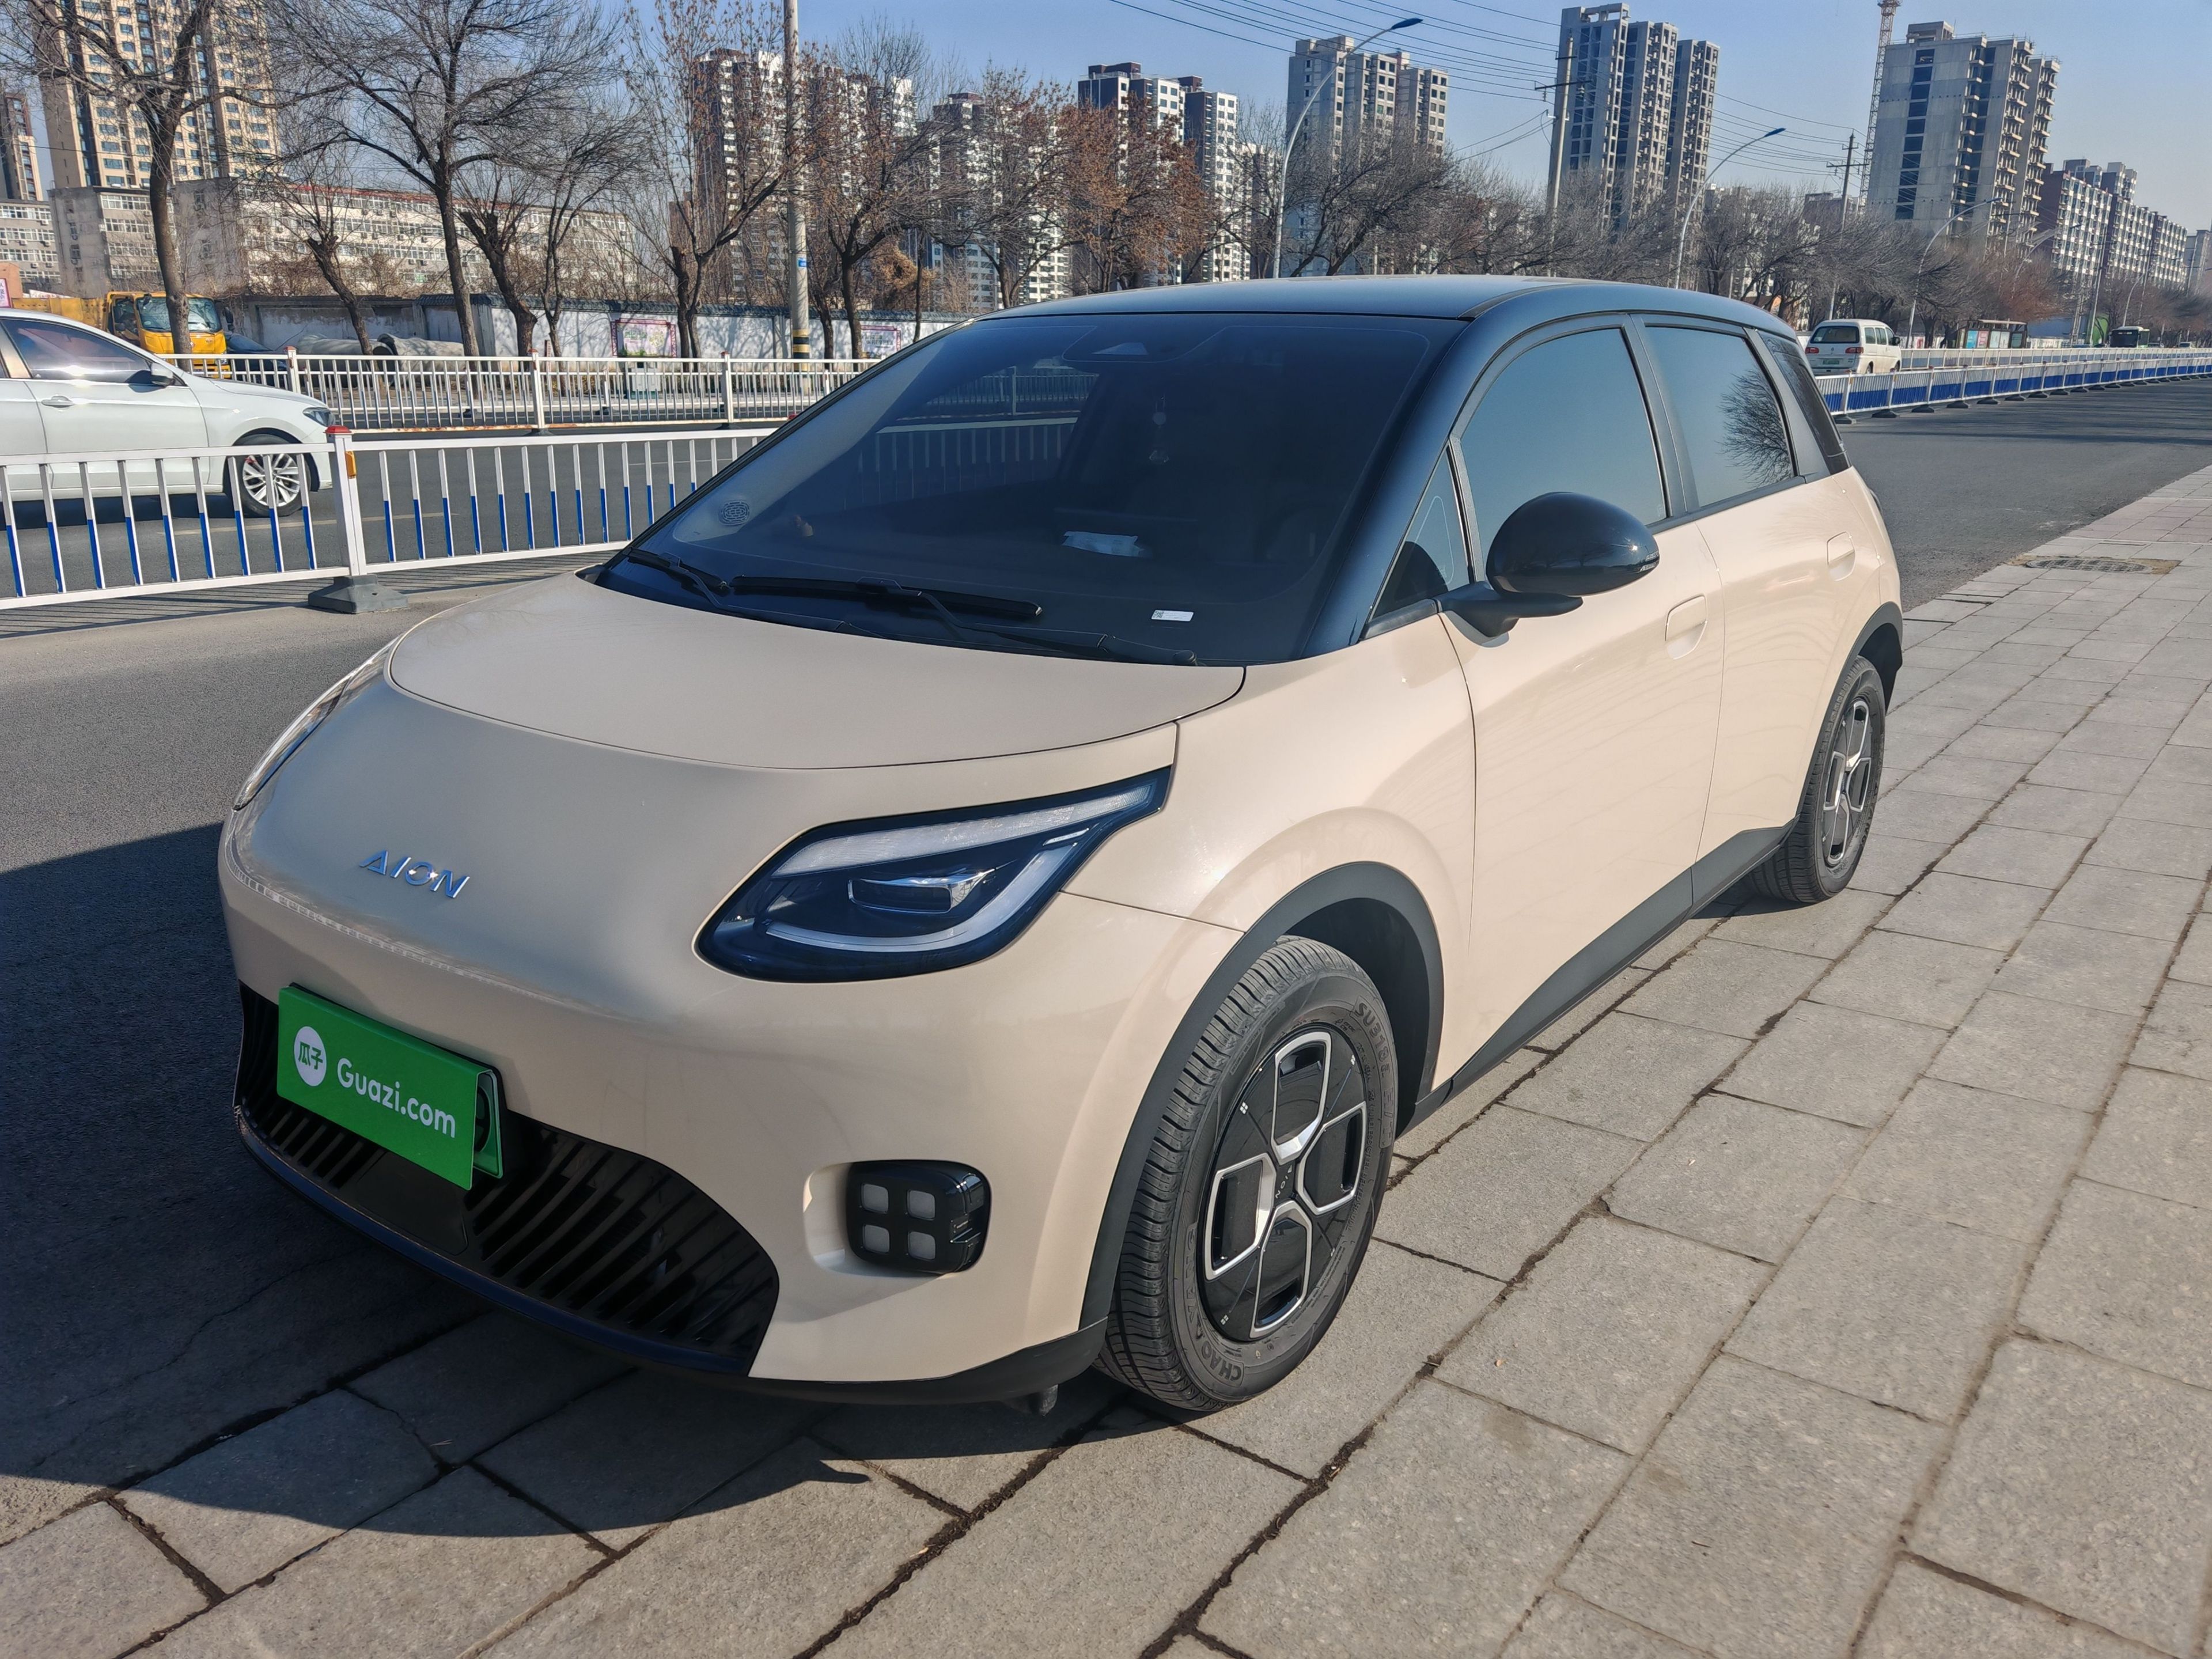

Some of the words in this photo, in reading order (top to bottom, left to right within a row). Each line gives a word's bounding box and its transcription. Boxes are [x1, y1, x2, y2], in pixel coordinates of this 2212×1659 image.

[359, 850, 470, 898] AION
[298, 1041, 323, 1070] 瓜子
[337, 1058, 456, 1138] Guazi.com
[1275, 1165, 1293, 1199] AION
